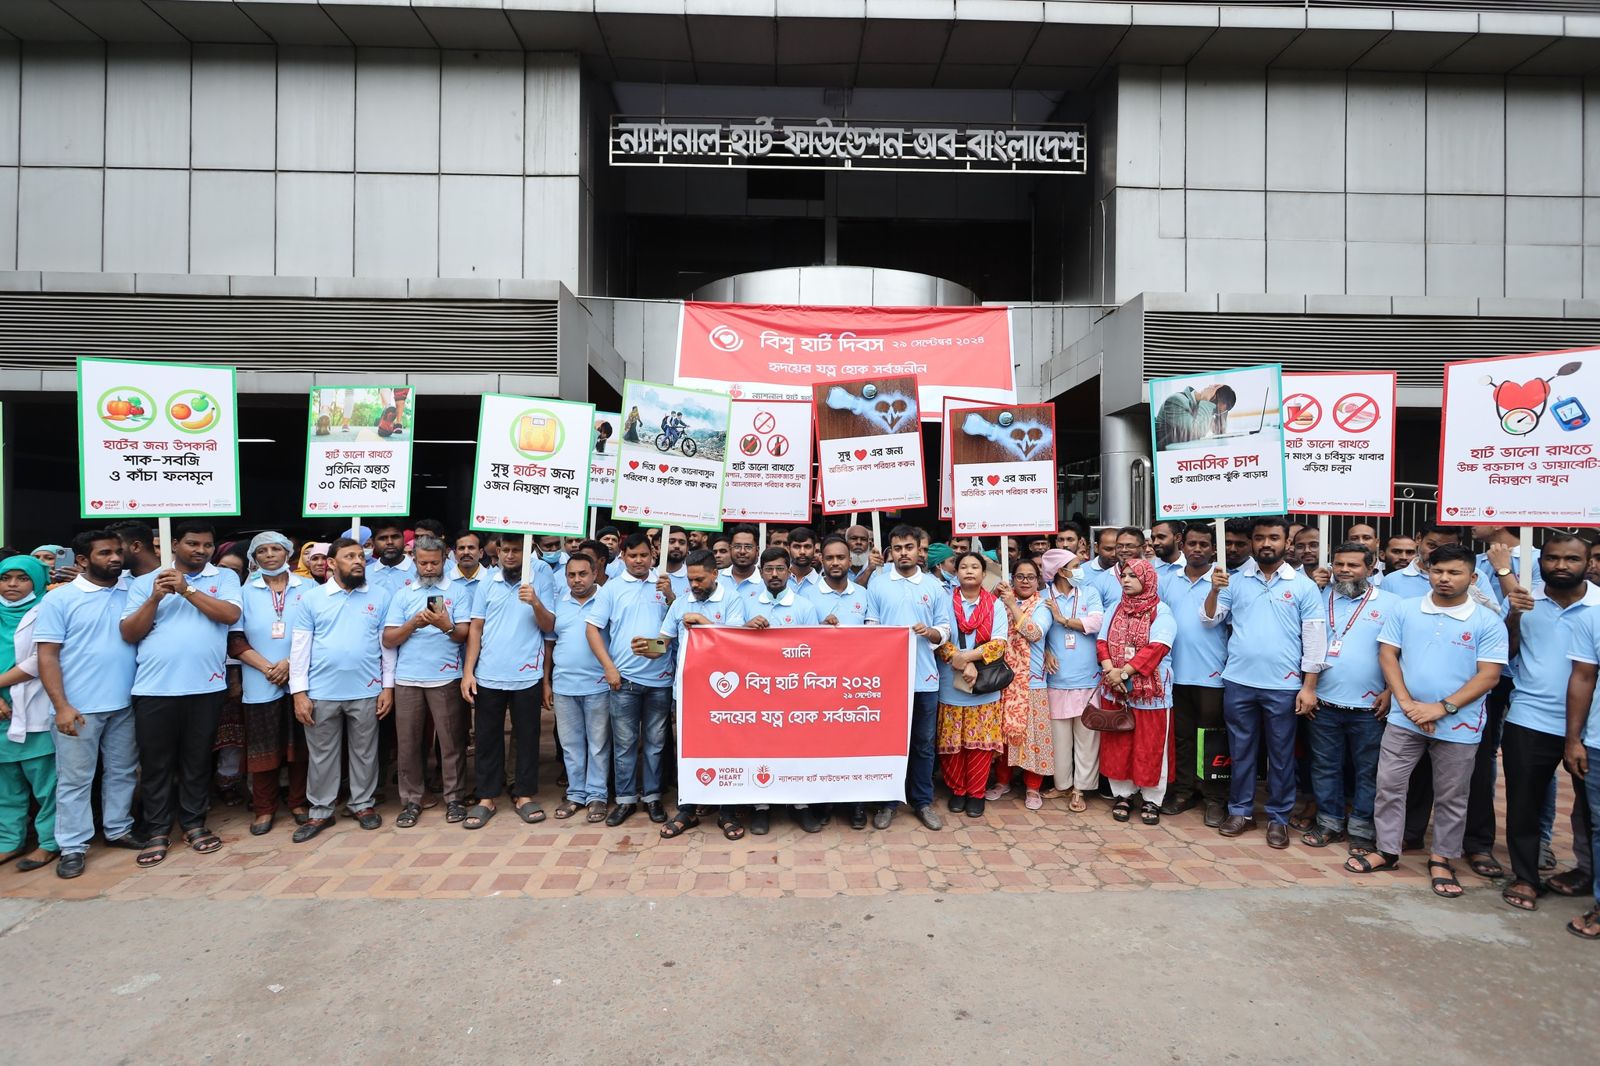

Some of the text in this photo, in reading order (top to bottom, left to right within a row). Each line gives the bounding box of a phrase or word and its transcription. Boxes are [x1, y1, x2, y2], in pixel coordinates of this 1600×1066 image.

[618, 122, 722, 154] ন্যাশনাল
[729, 116, 775, 158] হার্ট
[912, 128, 958, 160] অব
[965, 129, 1080, 164] বাংলাদেশ
[759, 330, 796, 355] বিশ্ব
[800, 333, 833, 352] হার্ট
[837, 331, 885, 352] দিবস
[892, 340, 908, 349] ২৯
[955, 336, 985, 346] ২০২৪
[768, 360, 928, 377] হৃদয়ের যত্ন হোক সর্বজনীন
[103, 438, 218, 452] হার্টের জন্য উপকারী
[1285, 437, 1371, 450] হার্ট ভালো রাখতে
[343, 450, 365, 459] ভালো
[368, 450, 393, 460] রাখতে
[837, 446, 904, 462] সুস্থ এর জন্য
[1292, 452, 1313, 461] মাংস
[1358, 453, 1385, 461] খাবার
[1470, 444, 1593, 459] হার্ট ভালো রাখতে
[123, 452, 200, 467] শাক-সবজি
[873, 460, 896, 470] পরিহার
[1177, 453, 1260, 472] মানসিক চাপ
[1457, 457, 1600, 472] উচ্চ রক্তচাপ ও ডায়াবেটি
[325, 461, 390, 476] প্রতিদিন অন্তত
[491, 462, 510, 479] সুস্থ
[513, 463, 547, 478] হার্টের
[550, 468, 576, 480] জন্য
[748, 462, 769, 471] ভালো
[771, 463, 795, 472] রাখতে
[1302, 461, 1352, 475] এড়িয়ে চলুন
[109, 468, 213, 486] ও কাঁচা ফলমূল
[623, 471, 648, 483] পরিবেশ
[970, 473, 1037, 487] সুস্থ এর জন্য
[1185, 472, 1221, 483] অ্যাটাকের
[1223, 469, 1240, 482] ঝুঁকি
[1242, 469, 1269, 480] বাড়ায়
[1488, 473, 1569, 487] নিয়ন্ত্রণে রাখুন
[318, 481, 335, 490] ৩০
[339, 477, 368, 490] মিনিট
[483, 479, 580, 500] ওজন নিয়ন্ত্রণে রাখুন
[1006, 487, 1028, 496] পরিহার
[745, 671, 881, 695] বিশ্ব হার্ট দিবস ২০২৪
[842, 692, 853, 700] ২৯
[709, 705, 881, 728] হৃদয়ের যত্ন হোক সর্বজনীন
